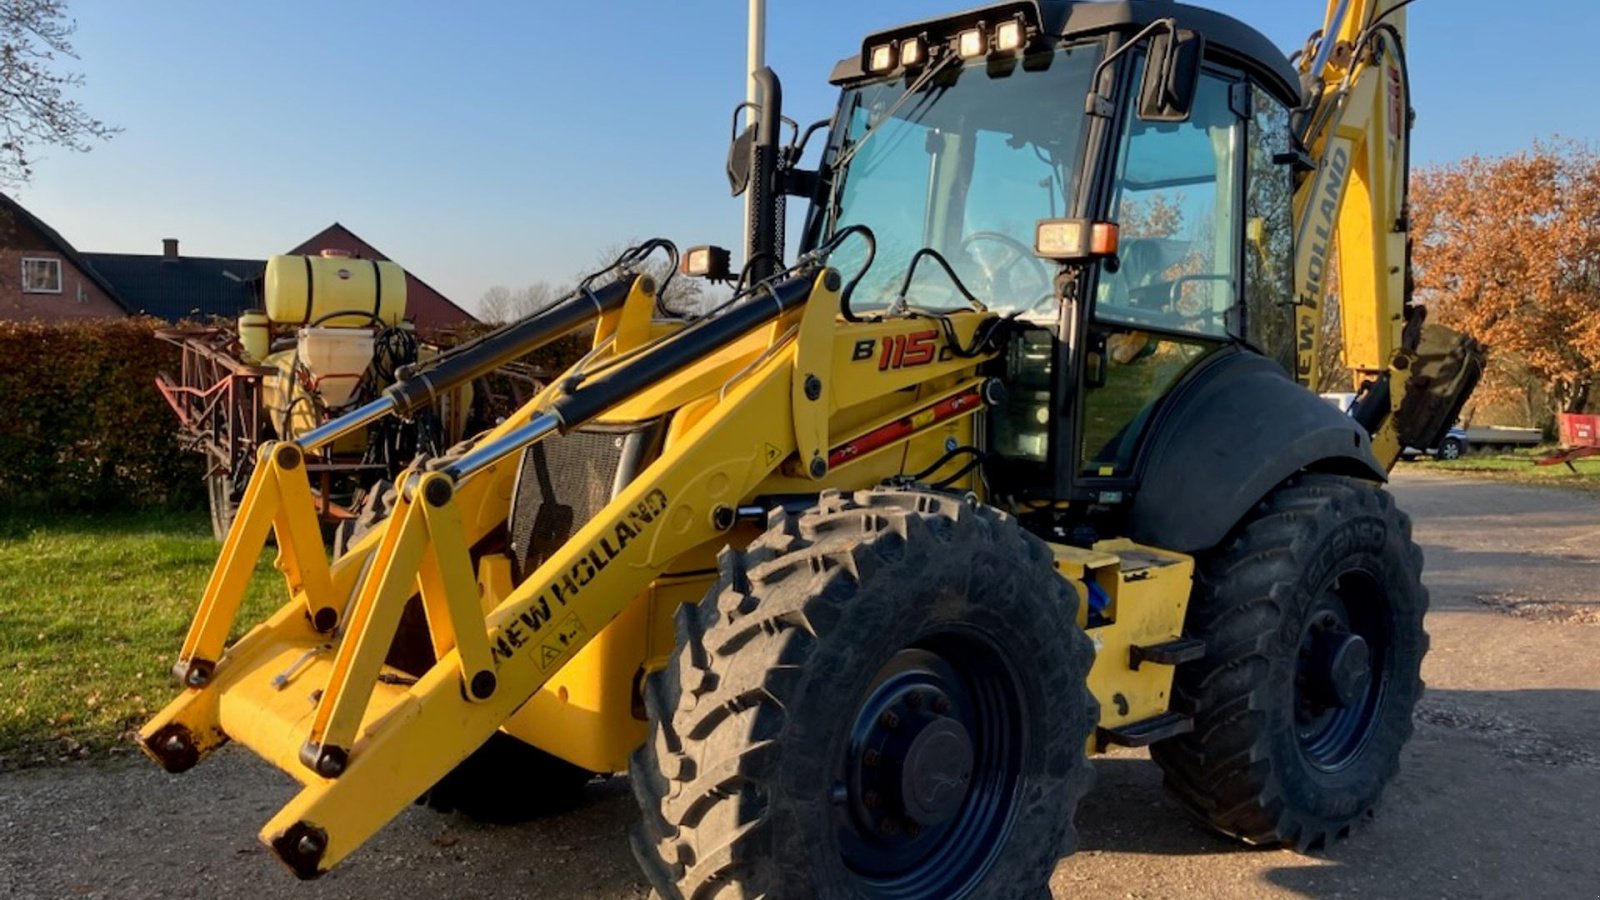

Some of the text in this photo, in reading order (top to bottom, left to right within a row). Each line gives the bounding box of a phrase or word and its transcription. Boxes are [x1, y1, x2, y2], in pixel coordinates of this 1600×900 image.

[1297, 146, 1348, 387] EW HOLLAND
[490, 488, 667, 665] NEW HOLLAND
